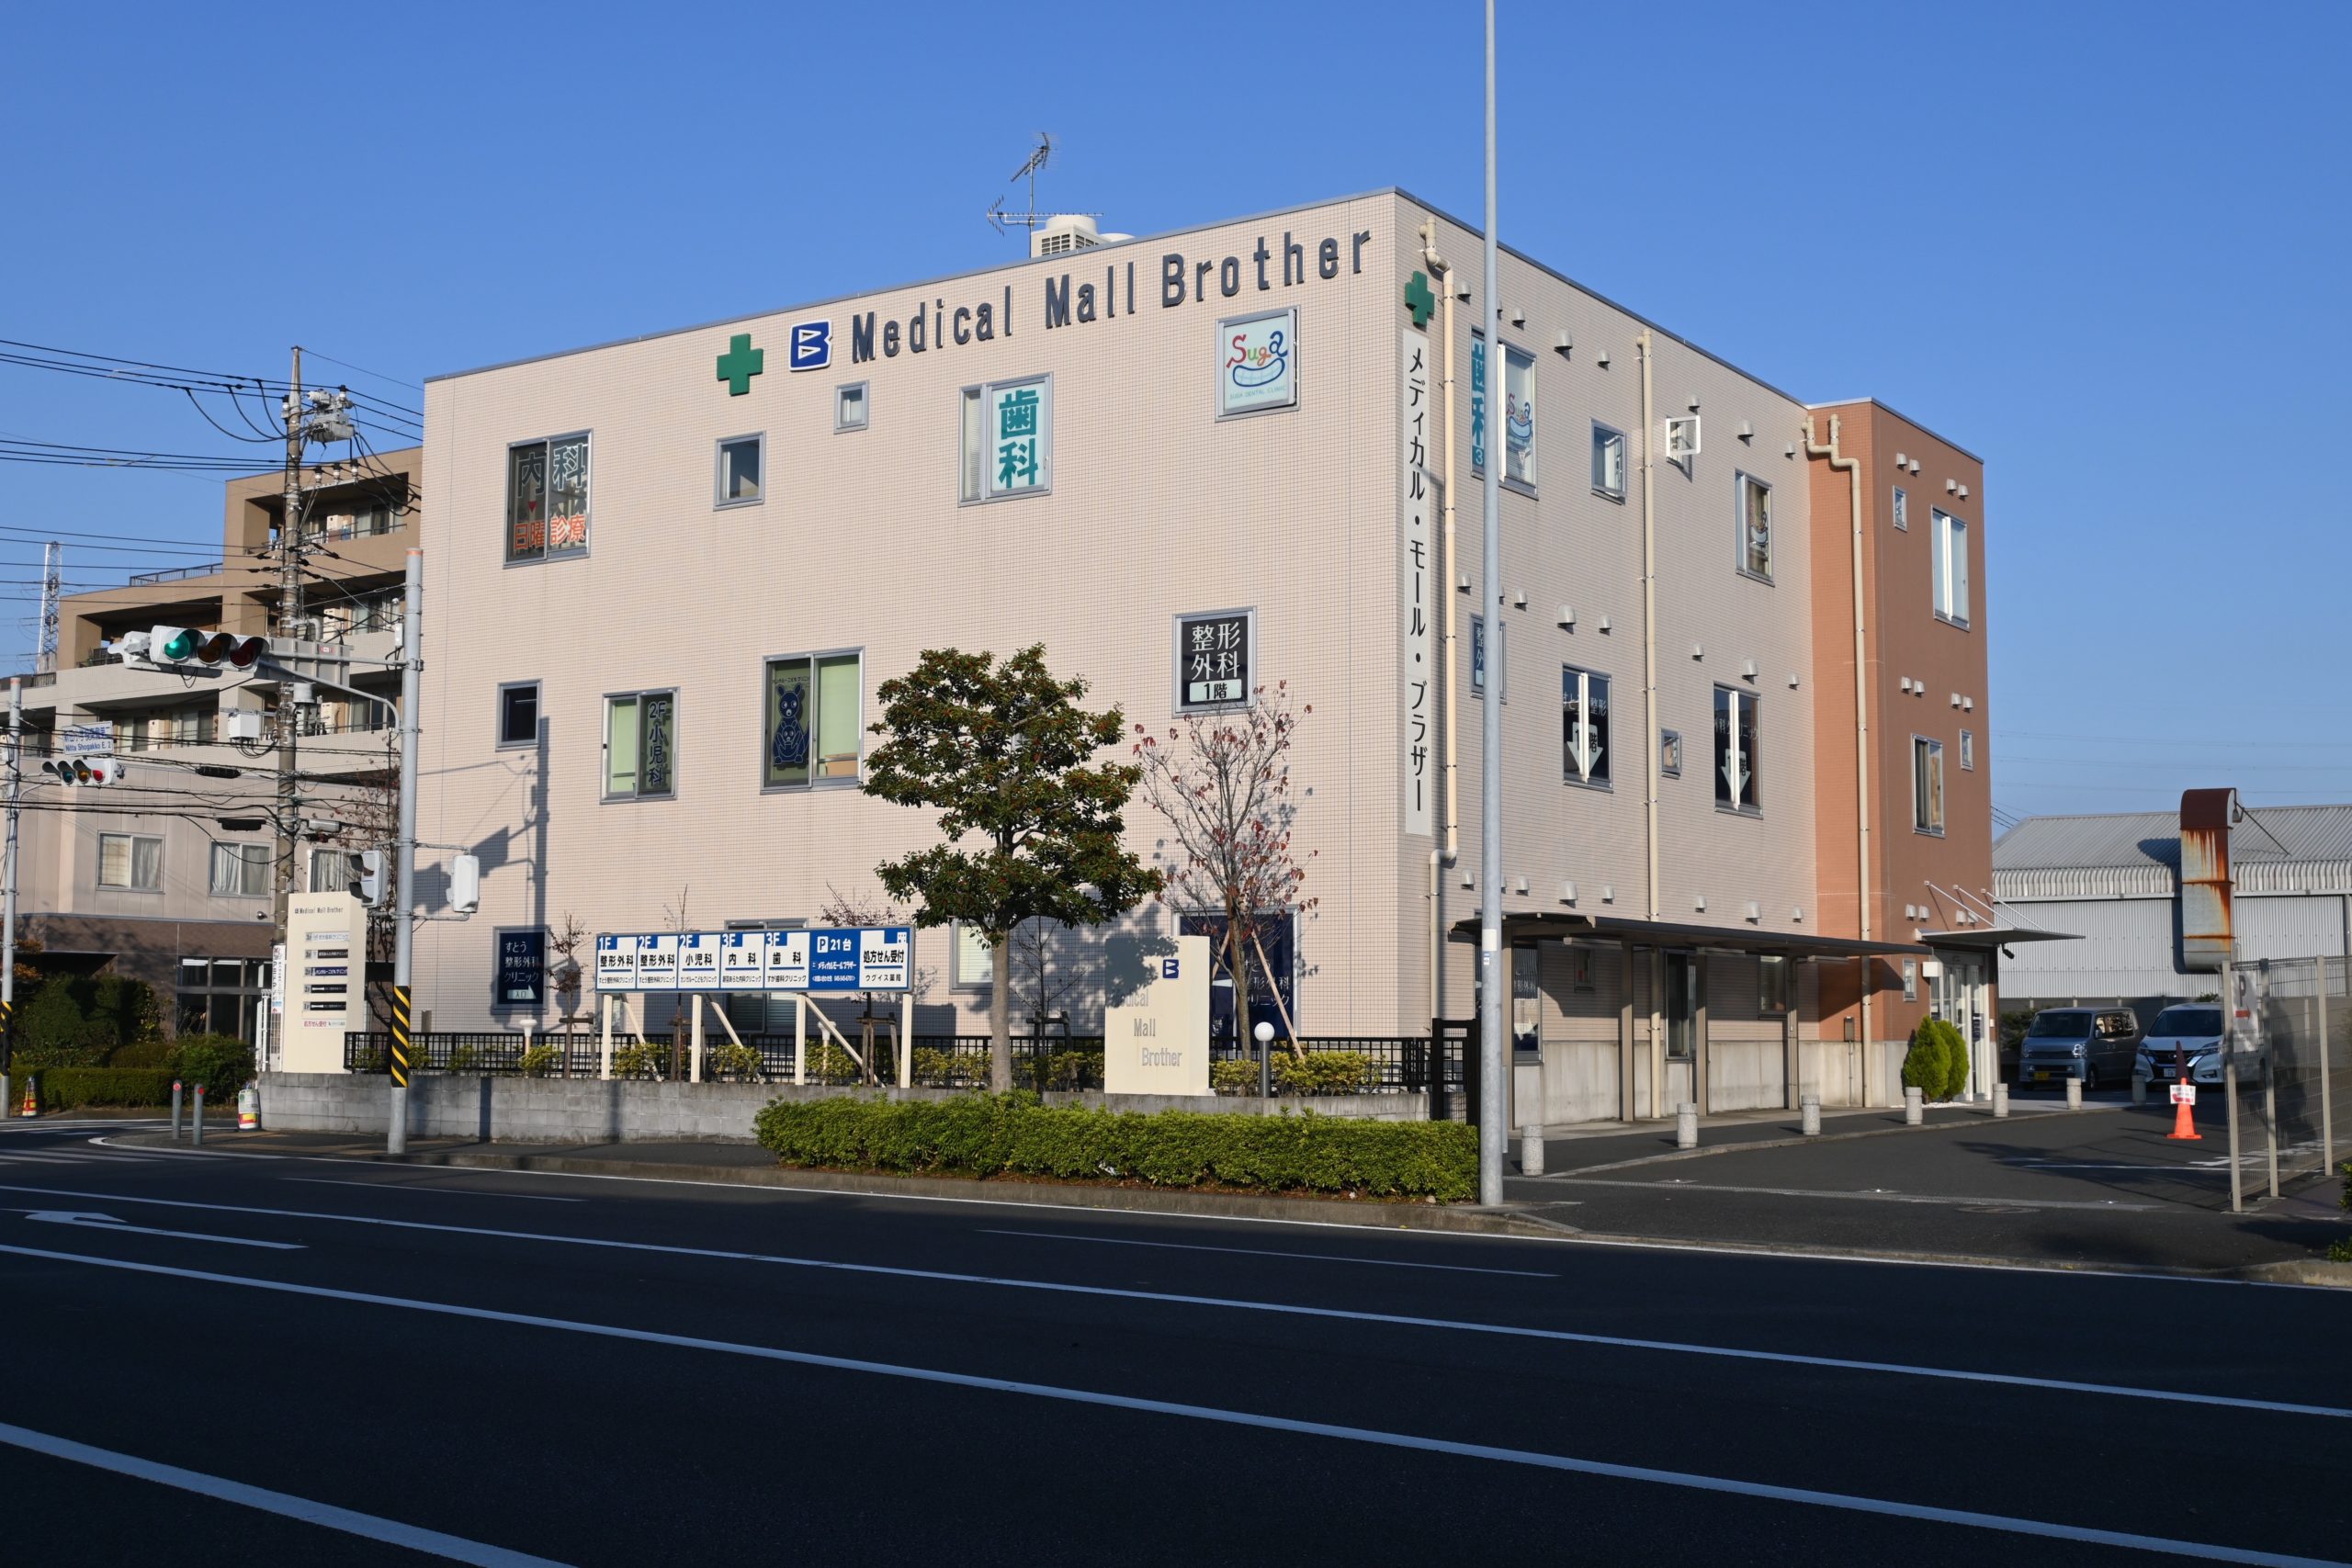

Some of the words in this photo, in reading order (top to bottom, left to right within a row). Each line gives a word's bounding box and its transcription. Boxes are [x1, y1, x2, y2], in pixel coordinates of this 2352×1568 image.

[853, 286, 1012, 364] Medical
[1046, 262, 1136, 329] Mall
[1162, 230, 1371, 309] Brother
[1226, 331, 1288, 368] Suga
[1268, 385, 1286, 393] CLINIC
[999, 389, 1039, 489] 歯科
[516, 443, 586, 498] 内科
[514, 514, 585, 549] 日曜診療
[1192, 622, 1241, 651] 整形
[1191, 650, 1240, 681] 外科
[1204, 682, 1227, 700] 1階
[649, 701, 666, 719] 2F
[77, 742, 101, 752] Shogakko
[649, 724, 664, 787] 小児科
[599, 937, 612, 950] 1F
[638, 936, 652, 949] 2F
[679, 935, 693, 948] 2F
[721, 933, 736, 947] 3F
[765, 932, 781, 947] 3F
[830, 938, 852, 951] 21台
[505, 941, 526, 953] すとう
[600, 955, 634, 967] 整形外科
[640, 953, 675, 967] 整形外科
[685, 953, 712, 966] 小児科
[864, 950, 905, 964] 処方せん受付
[504, 971, 539, 983] クリニック
[767, 975, 807, 983] すが歯科クリニック
[865, 974, 901, 982] ウグイス薬局
[2238, 975, 2246, 1007] P
[1134, 1018, 1156, 1037] Mall
[1142, 1048, 1182, 1066] Brother
